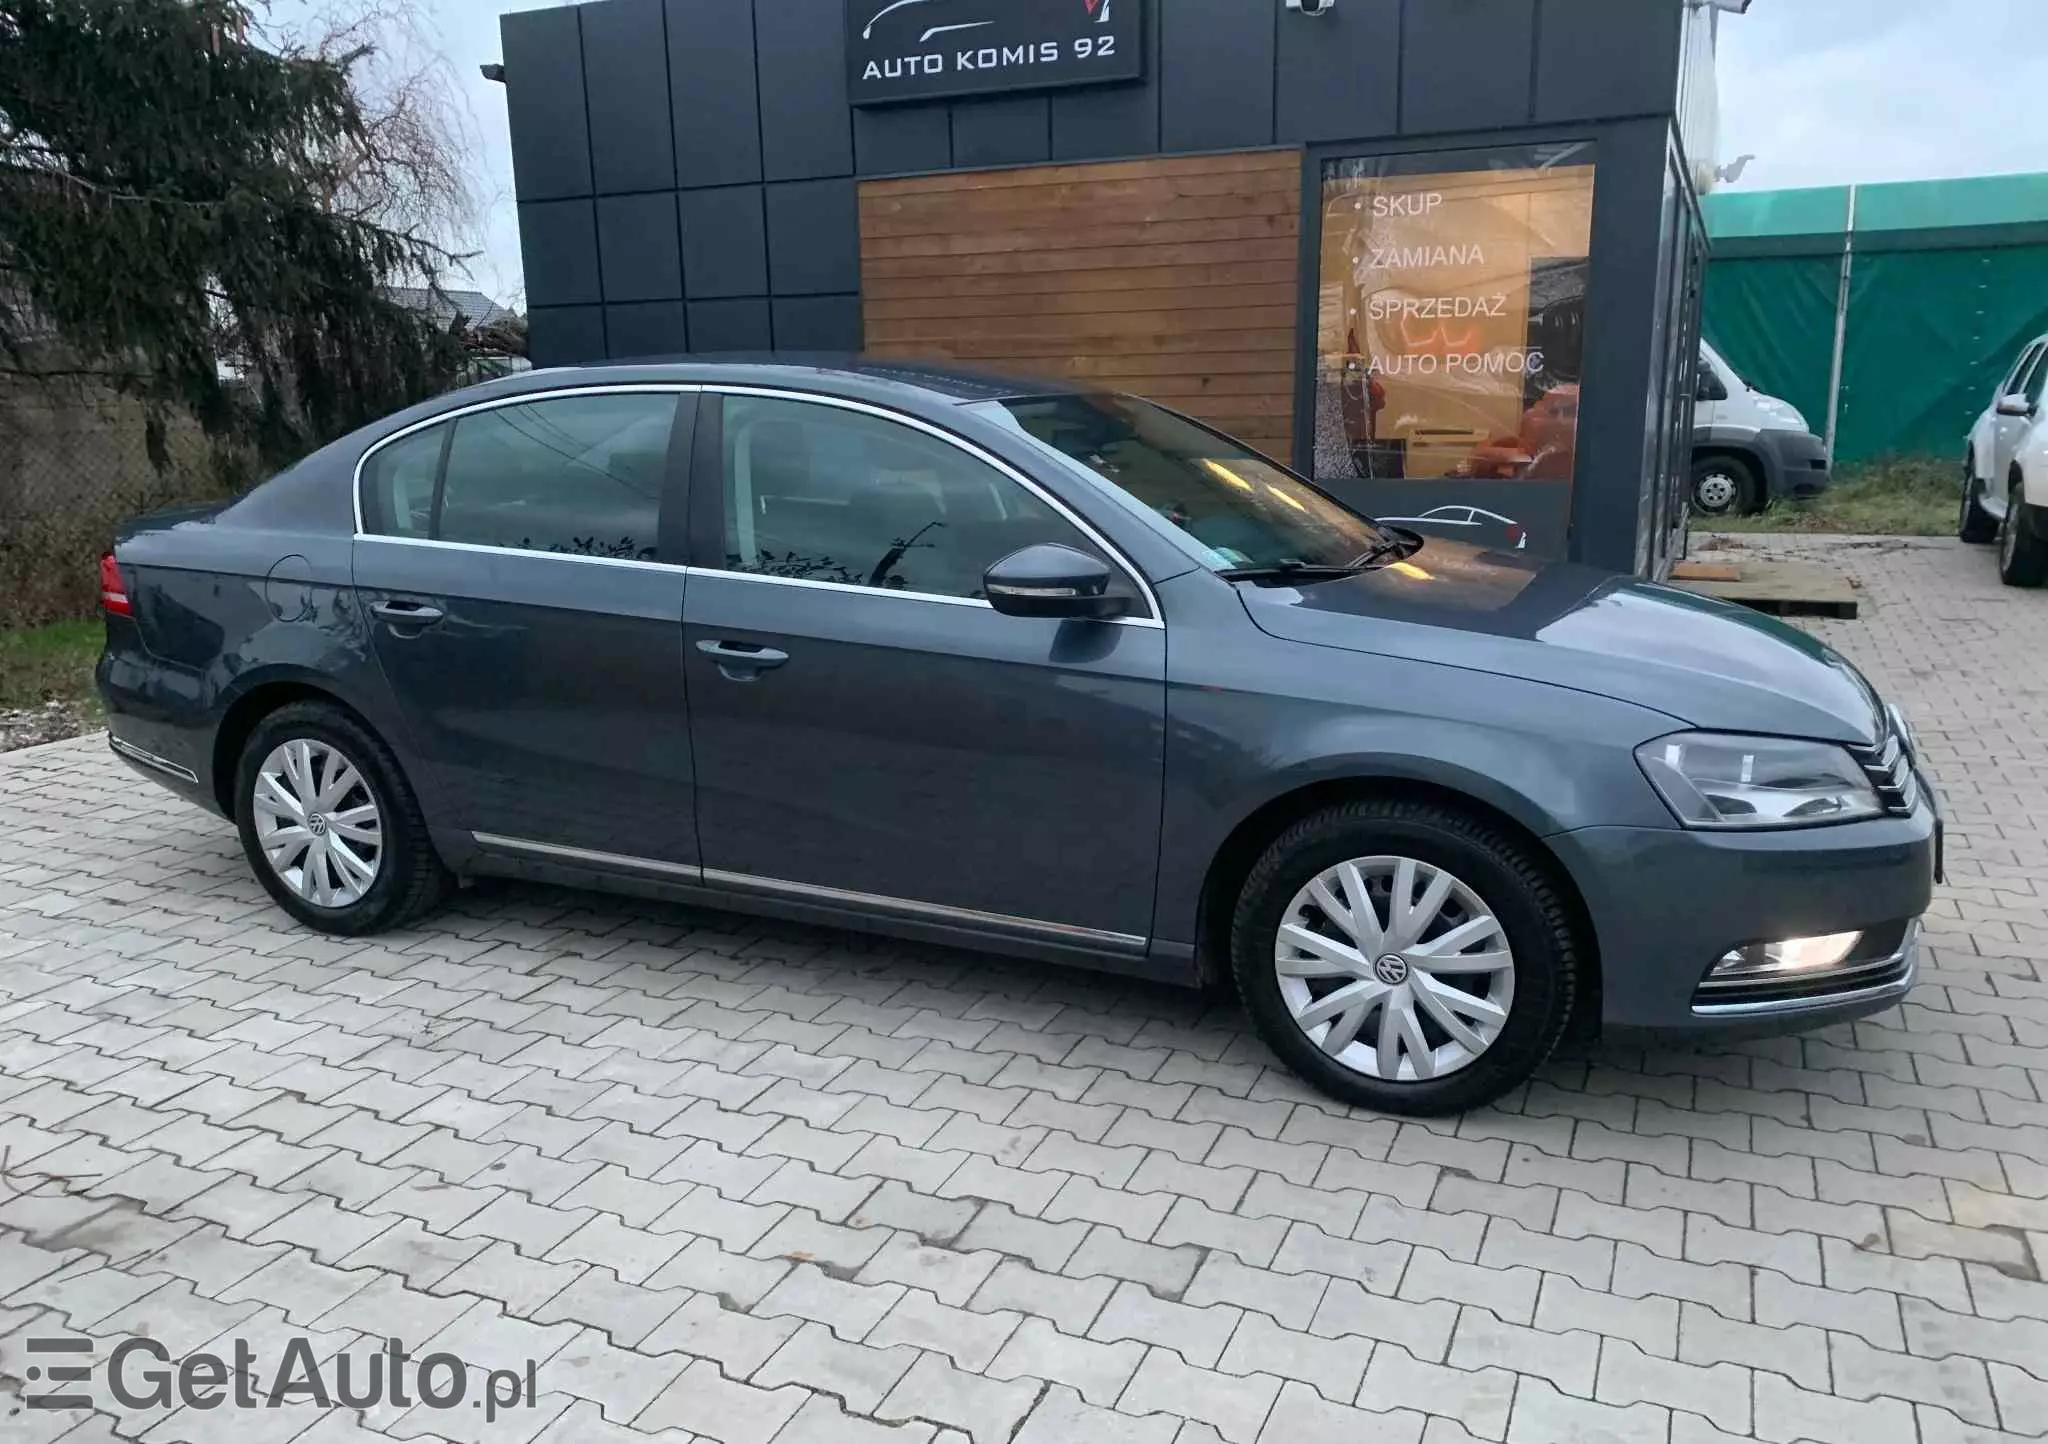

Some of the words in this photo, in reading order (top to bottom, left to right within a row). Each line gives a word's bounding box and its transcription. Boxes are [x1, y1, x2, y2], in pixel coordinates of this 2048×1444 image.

[862, 54, 943, 80] AUTO
[956, 42, 1058, 71] KOMIS
[1074, 36, 1115, 59] 92
[1372, 193, 1442, 217] SKUP
[1370, 244, 1484, 269] ZAMIANA
[1367, 355, 1437, 375] AUTO
[1446, 352, 1544, 374] POMOC
